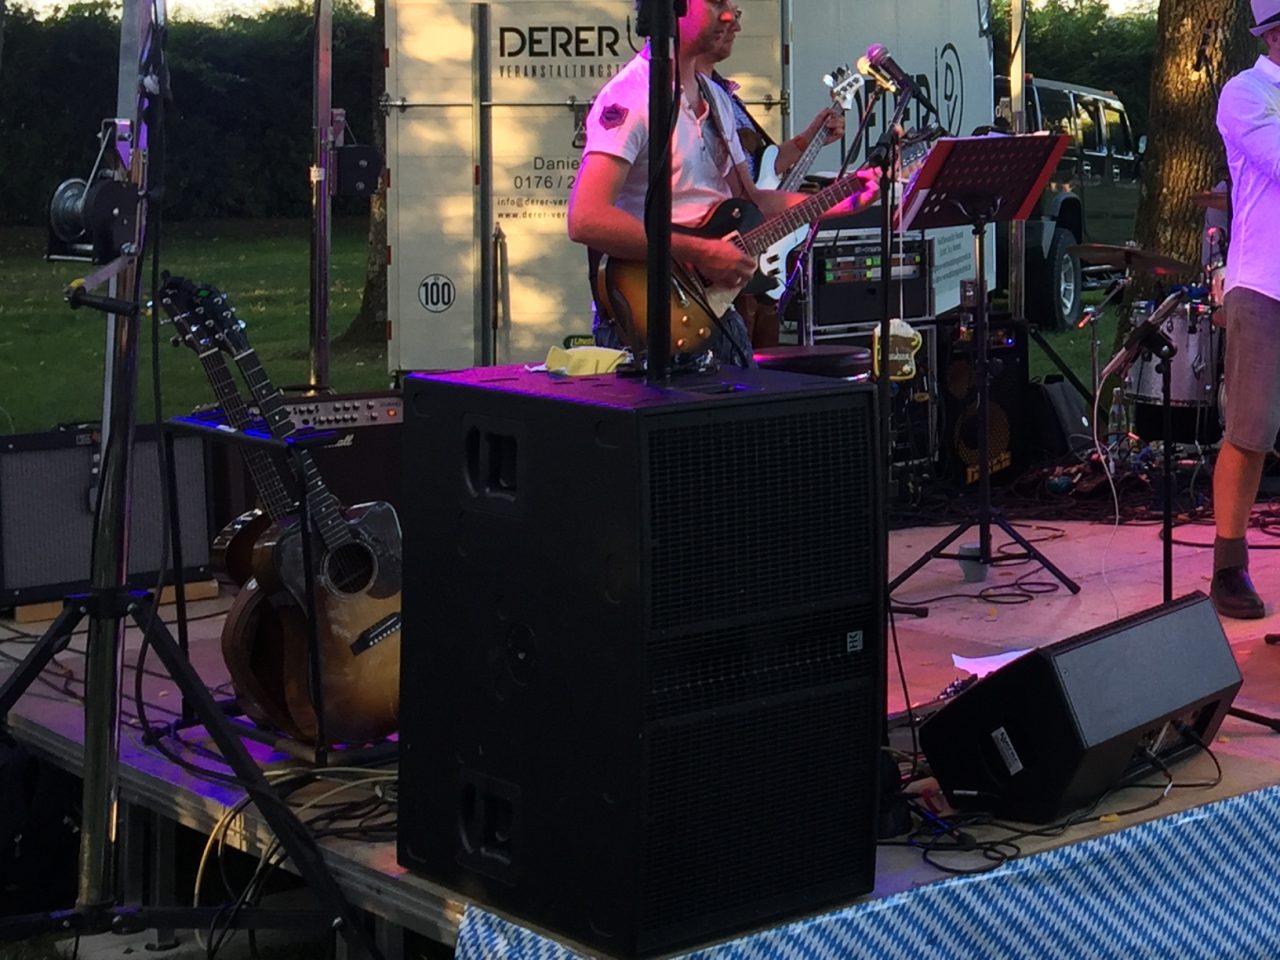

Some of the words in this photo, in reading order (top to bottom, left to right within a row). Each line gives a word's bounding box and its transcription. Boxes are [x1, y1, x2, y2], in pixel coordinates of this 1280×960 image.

[499, 25, 620, 58] DERER
[513, 175, 553, 189] 0176
[422, 281, 451, 306] 100
